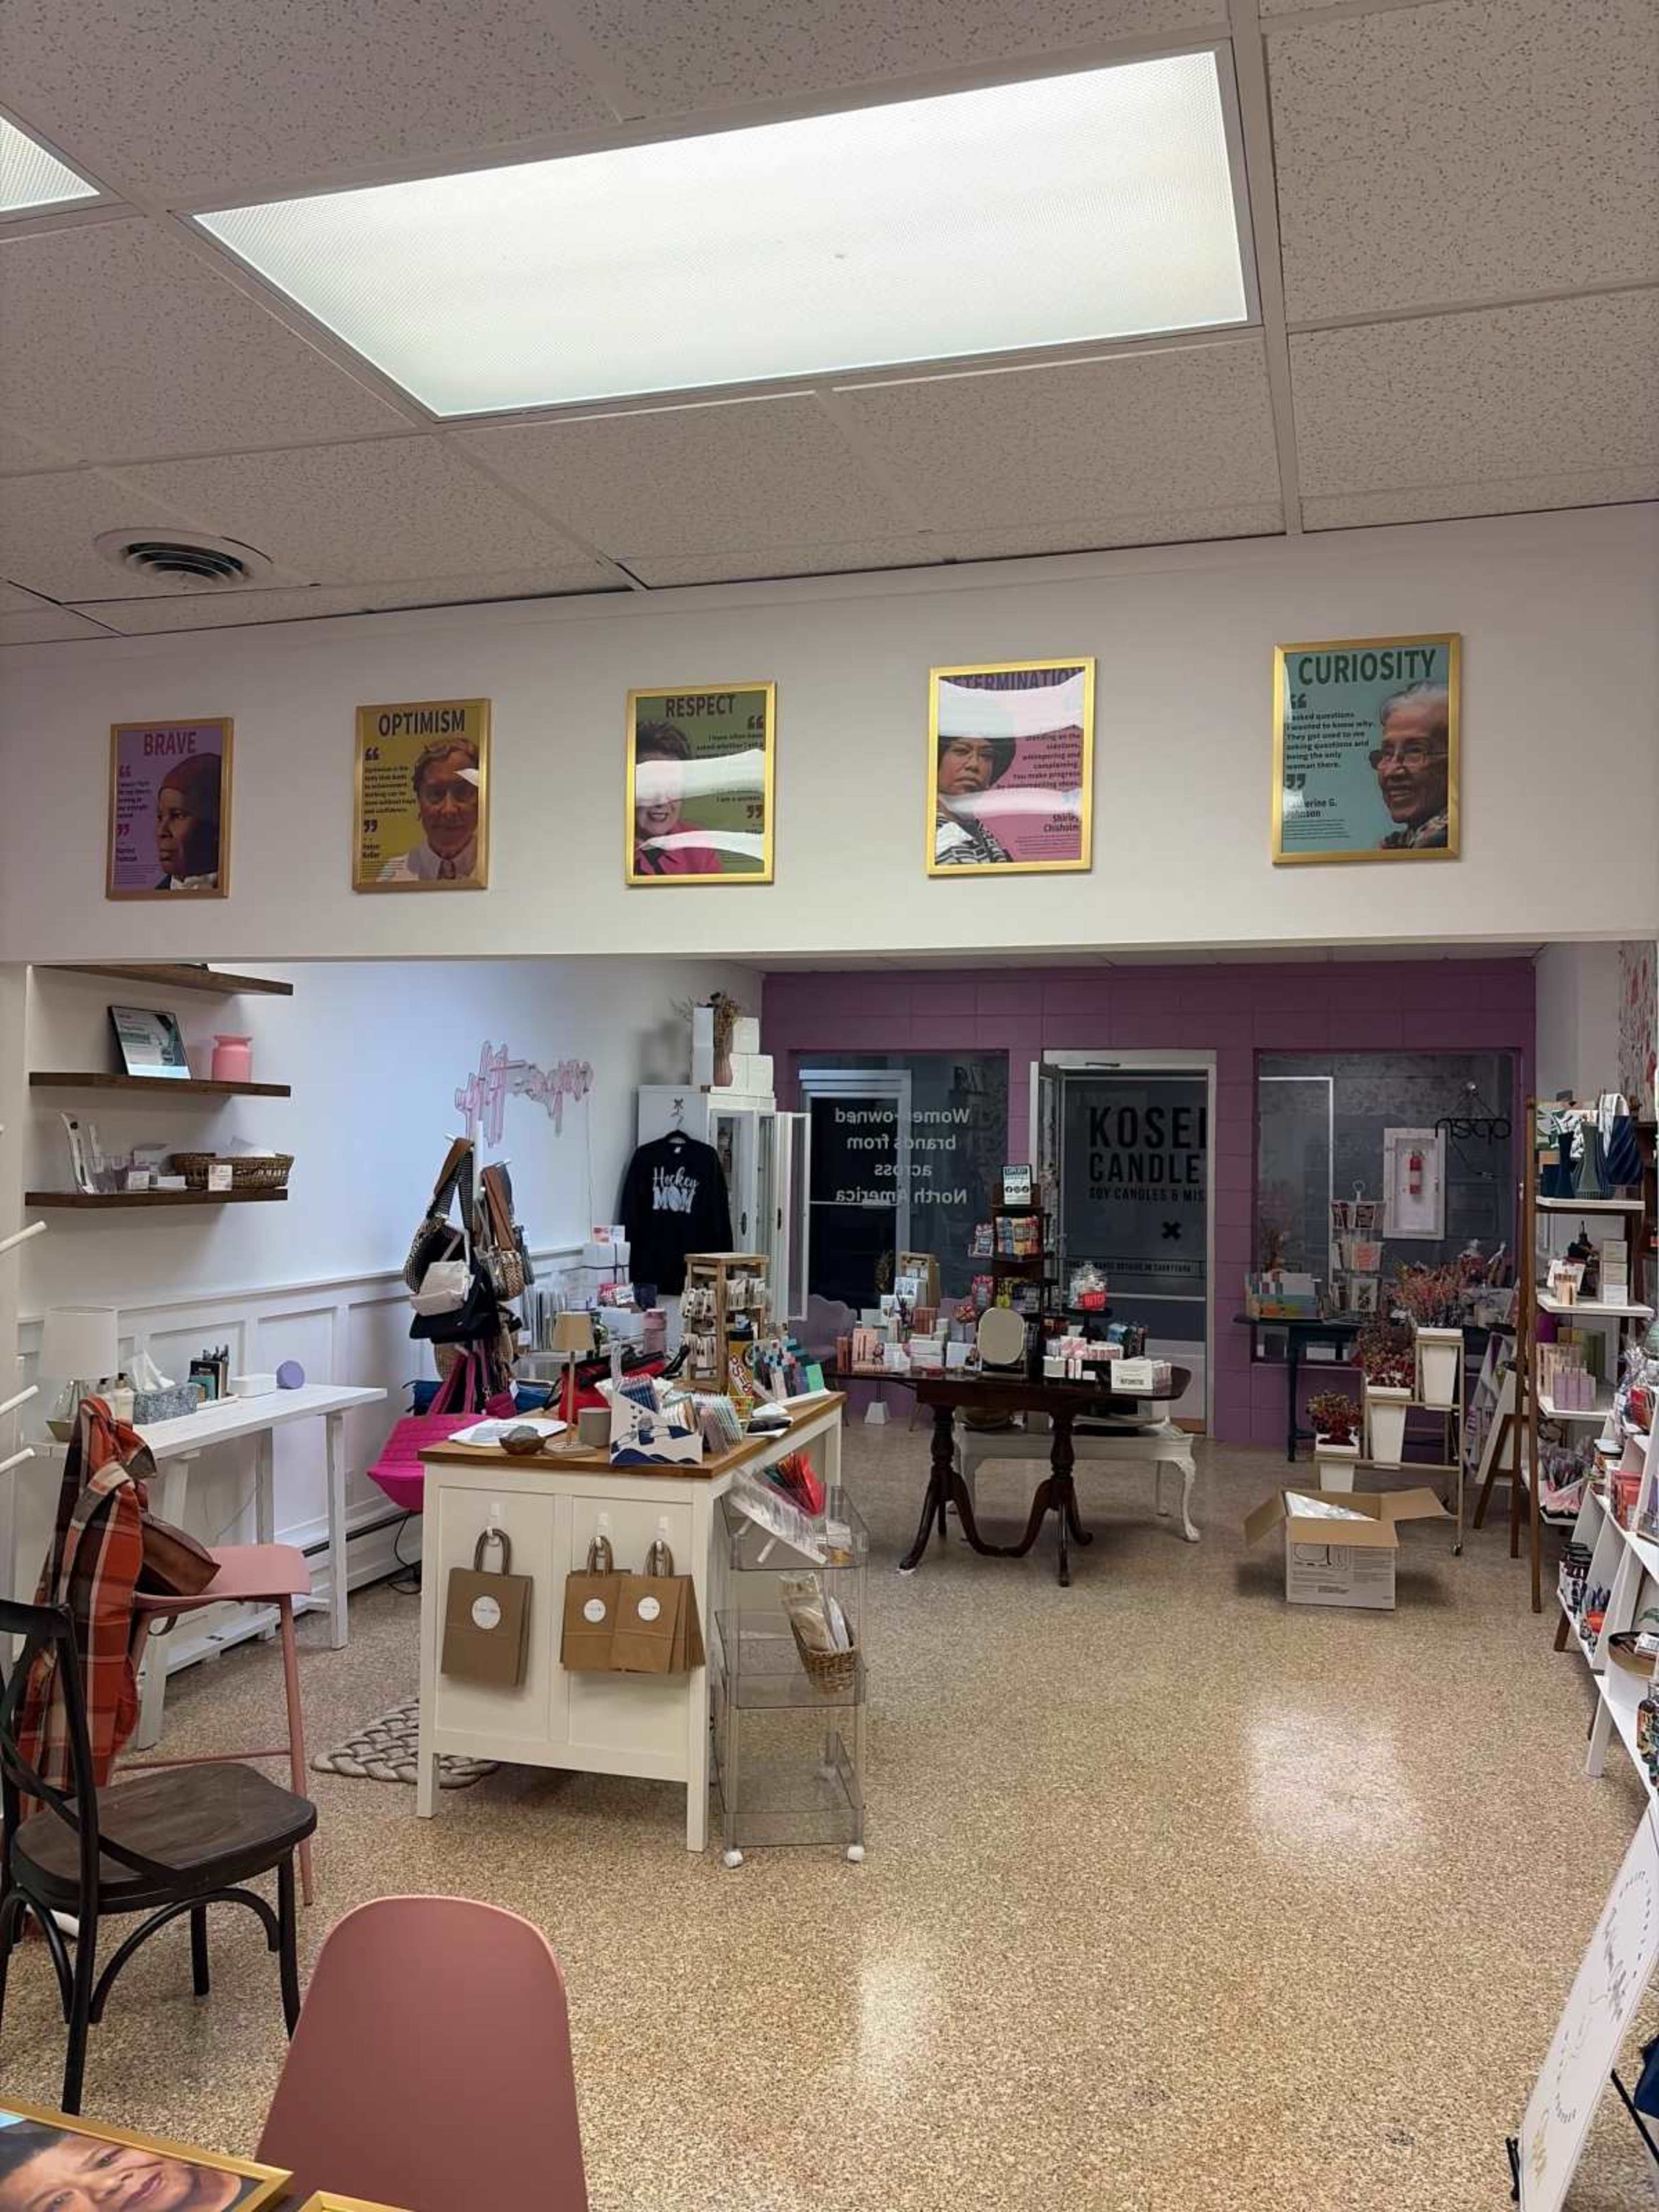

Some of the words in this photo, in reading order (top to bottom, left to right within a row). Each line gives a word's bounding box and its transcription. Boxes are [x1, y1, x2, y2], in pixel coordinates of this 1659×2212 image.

[1299, 650, 1436, 686] CURIOSITY
[665, 694, 736, 718] RESPECT
[1316, 712, 1354, 721] questions
[378, 709, 465, 736] OPTIMISM
[143, 731, 196, 756] BRAVE
[1314, 741, 1353, 750] questions
[652, 1166, 699, 1192] Hockey
[1089, 1152, 1200, 1184] CANDLE
[1089, 1186, 1112, 1200] SOY
[1114, 1187, 1166, 1202] CANDLES
